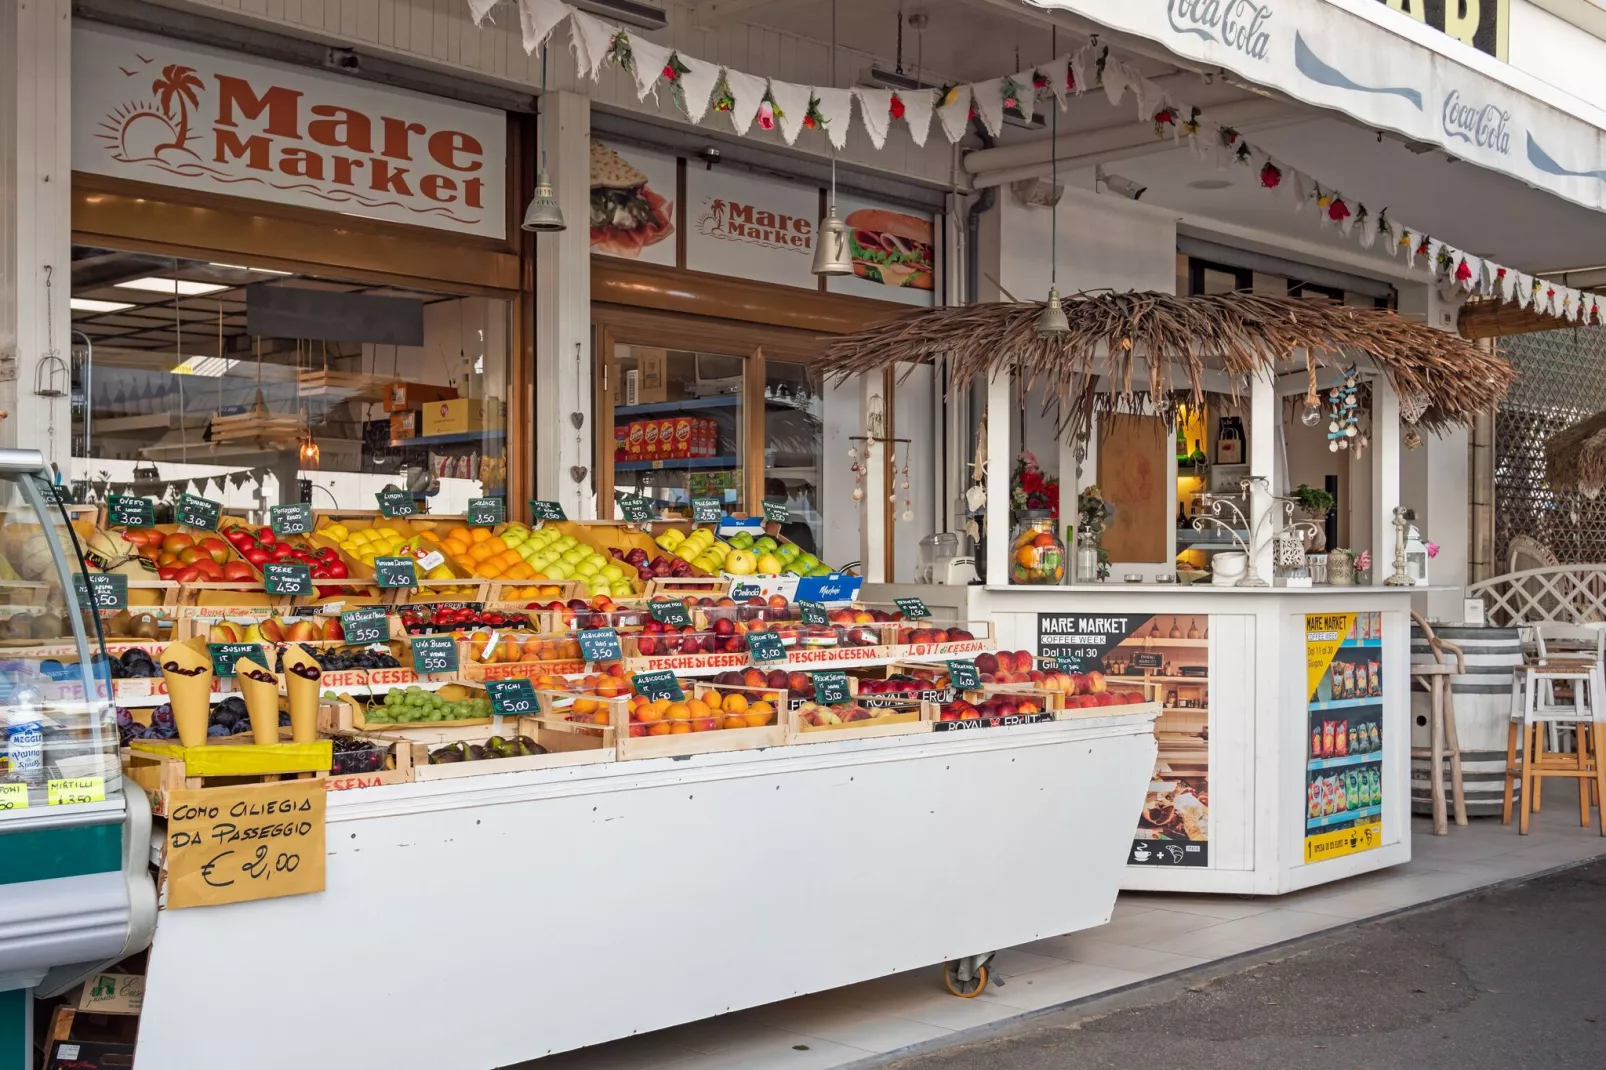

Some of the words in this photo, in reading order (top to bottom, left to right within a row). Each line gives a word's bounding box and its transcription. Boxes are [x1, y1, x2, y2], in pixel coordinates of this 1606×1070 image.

[213, 73, 484, 174] Mare
[212, 128, 485, 209] Market
[728, 201, 812, 235] Mare
[728, 221, 812, 249] Market
[392, 506, 412, 515] 4,00
[120, 514, 143, 524] 3,00
[186, 514, 206, 526] 3,00
[632, 512, 648, 522] 3,50
[282, 522, 304, 533] 3,00
[389, 576, 410, 586] 4,50
[276, 583, 300, 593] 4,50
[732, 586, 760, 597] Melinda
[664, 615, 684, 624] 1,50
[1042, 618, 1075, 633] MARE
[1079, 618, 1128, 633] MARKET
[1306, 616, 1322, 631] MARE
[1324, 616, 1346, 630] MARKET
[356, 629, 380, 641] 5,50
[1041, 636, 1077, 644] COFFEE
[1079, 636, 1106, 644] WEEK
[592, 648, 612, 660] 3,50
[761, 648, 780, 659] 2,00
[947, 642, 984, 654] CESENA
[1043, 648, 1059, 657] Dal
[1075, 648, 1084, 657] al
[1086, 648, 1098, 657] 30
[649, 656, 694, 670] PESCHE
[707, 654, 749, 668] CESENA
[789, 652, 827, 664] PESCHE
[838, 648, 876, 660] CESENA
[424, 659, 447, 671] 5,50
[552, 660, 604, 674] CESEA
[1042, 661, 1058, 670] Giu
[322, 670, 354, 687] CHE
[372, 668, 418, 684] CESEN
[637, 673, 672, 684] ALBICOCCHE
[960, 676, 975, 687] 4,00
[825, 690, 842, 701] 5,00
[923, 690, 950, 702] FRUI
[503, 700, 529, 712] 5,00
[14, 734, 42, 743] MEGGLE
[322, 776, 382, 790] ESENA
[0, 786, 20, 794] PONI
[171, 832, 202, 849] DA
[211, 821, 312, 844] PASSEGGIO
[201, 850, 235, 887] €
[242, 844, 300, 880] 2,00
